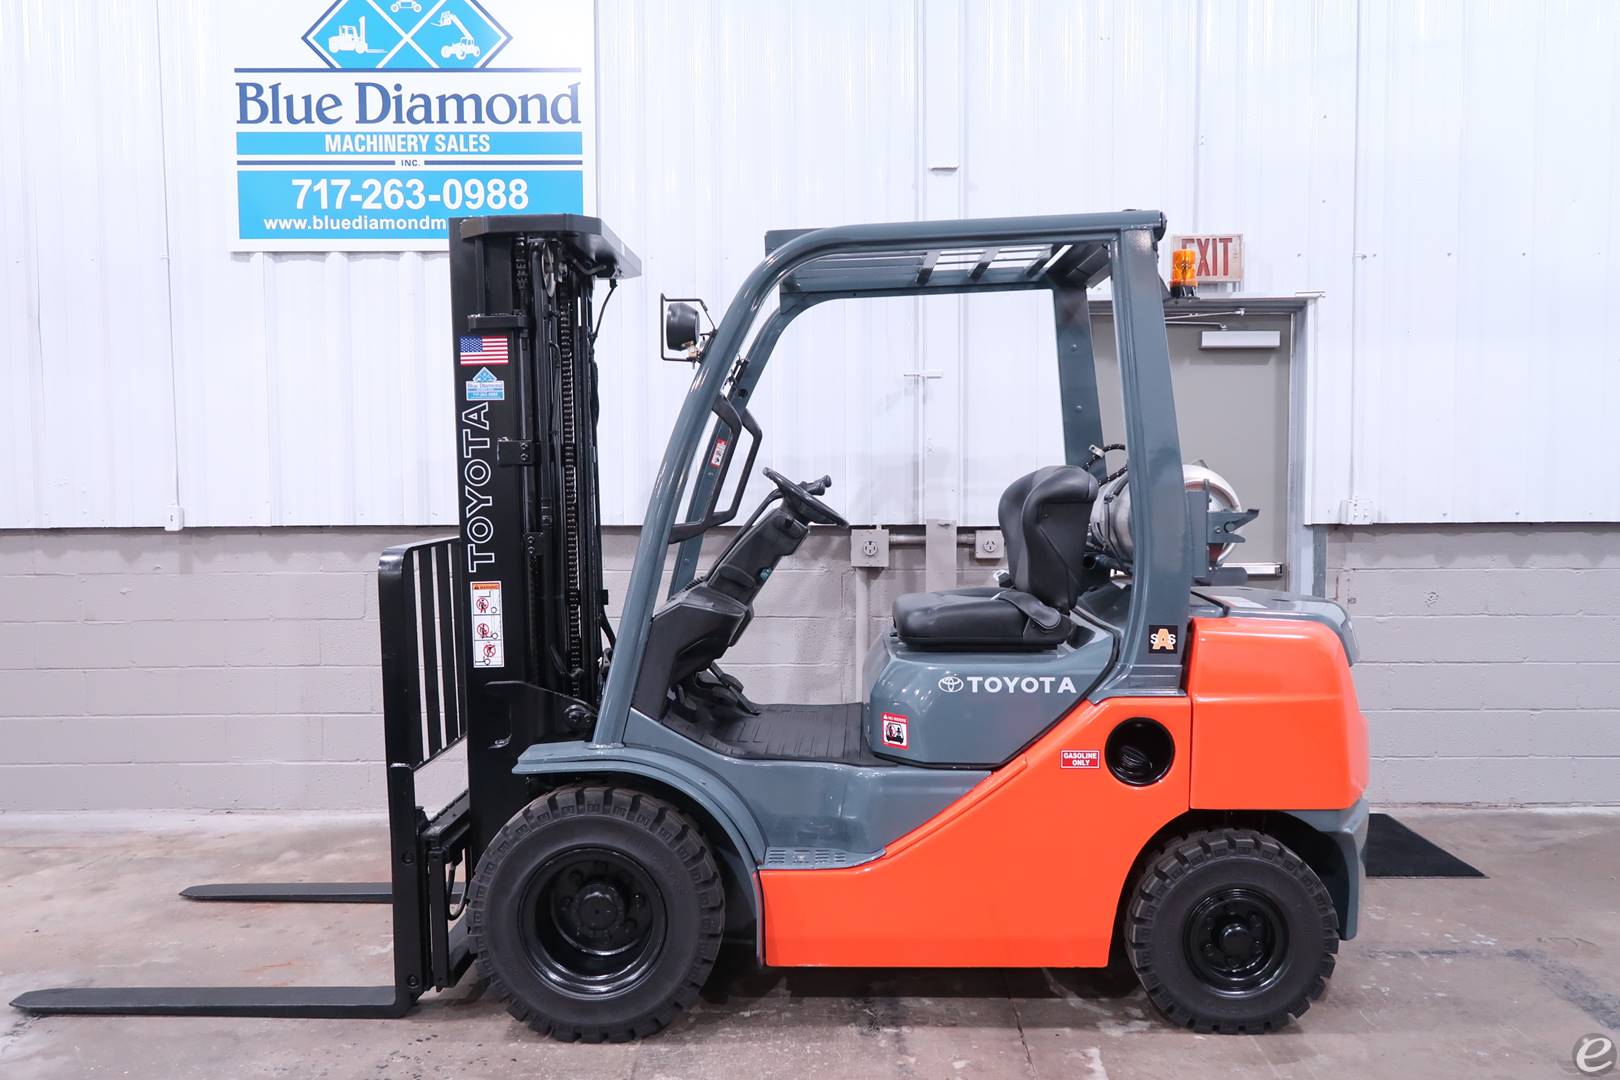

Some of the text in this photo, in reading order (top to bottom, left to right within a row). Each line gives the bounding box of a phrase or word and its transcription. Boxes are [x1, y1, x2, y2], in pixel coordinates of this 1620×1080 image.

[236, 81, 582, 125] Blue Diamond
[324, 133, 491, 153] MACHINERY SALES
[401, 159, 421, 167] INC.
[291, 178, 529, 210] 717-263-0988
[264, 215, 446, 230] www.bluediamondm
[462, 402, 495, 573] TOYOTA
[967, 676, 1077, 694] TOYOTA
[1063, 752, 1097, 760] GASOLINE
